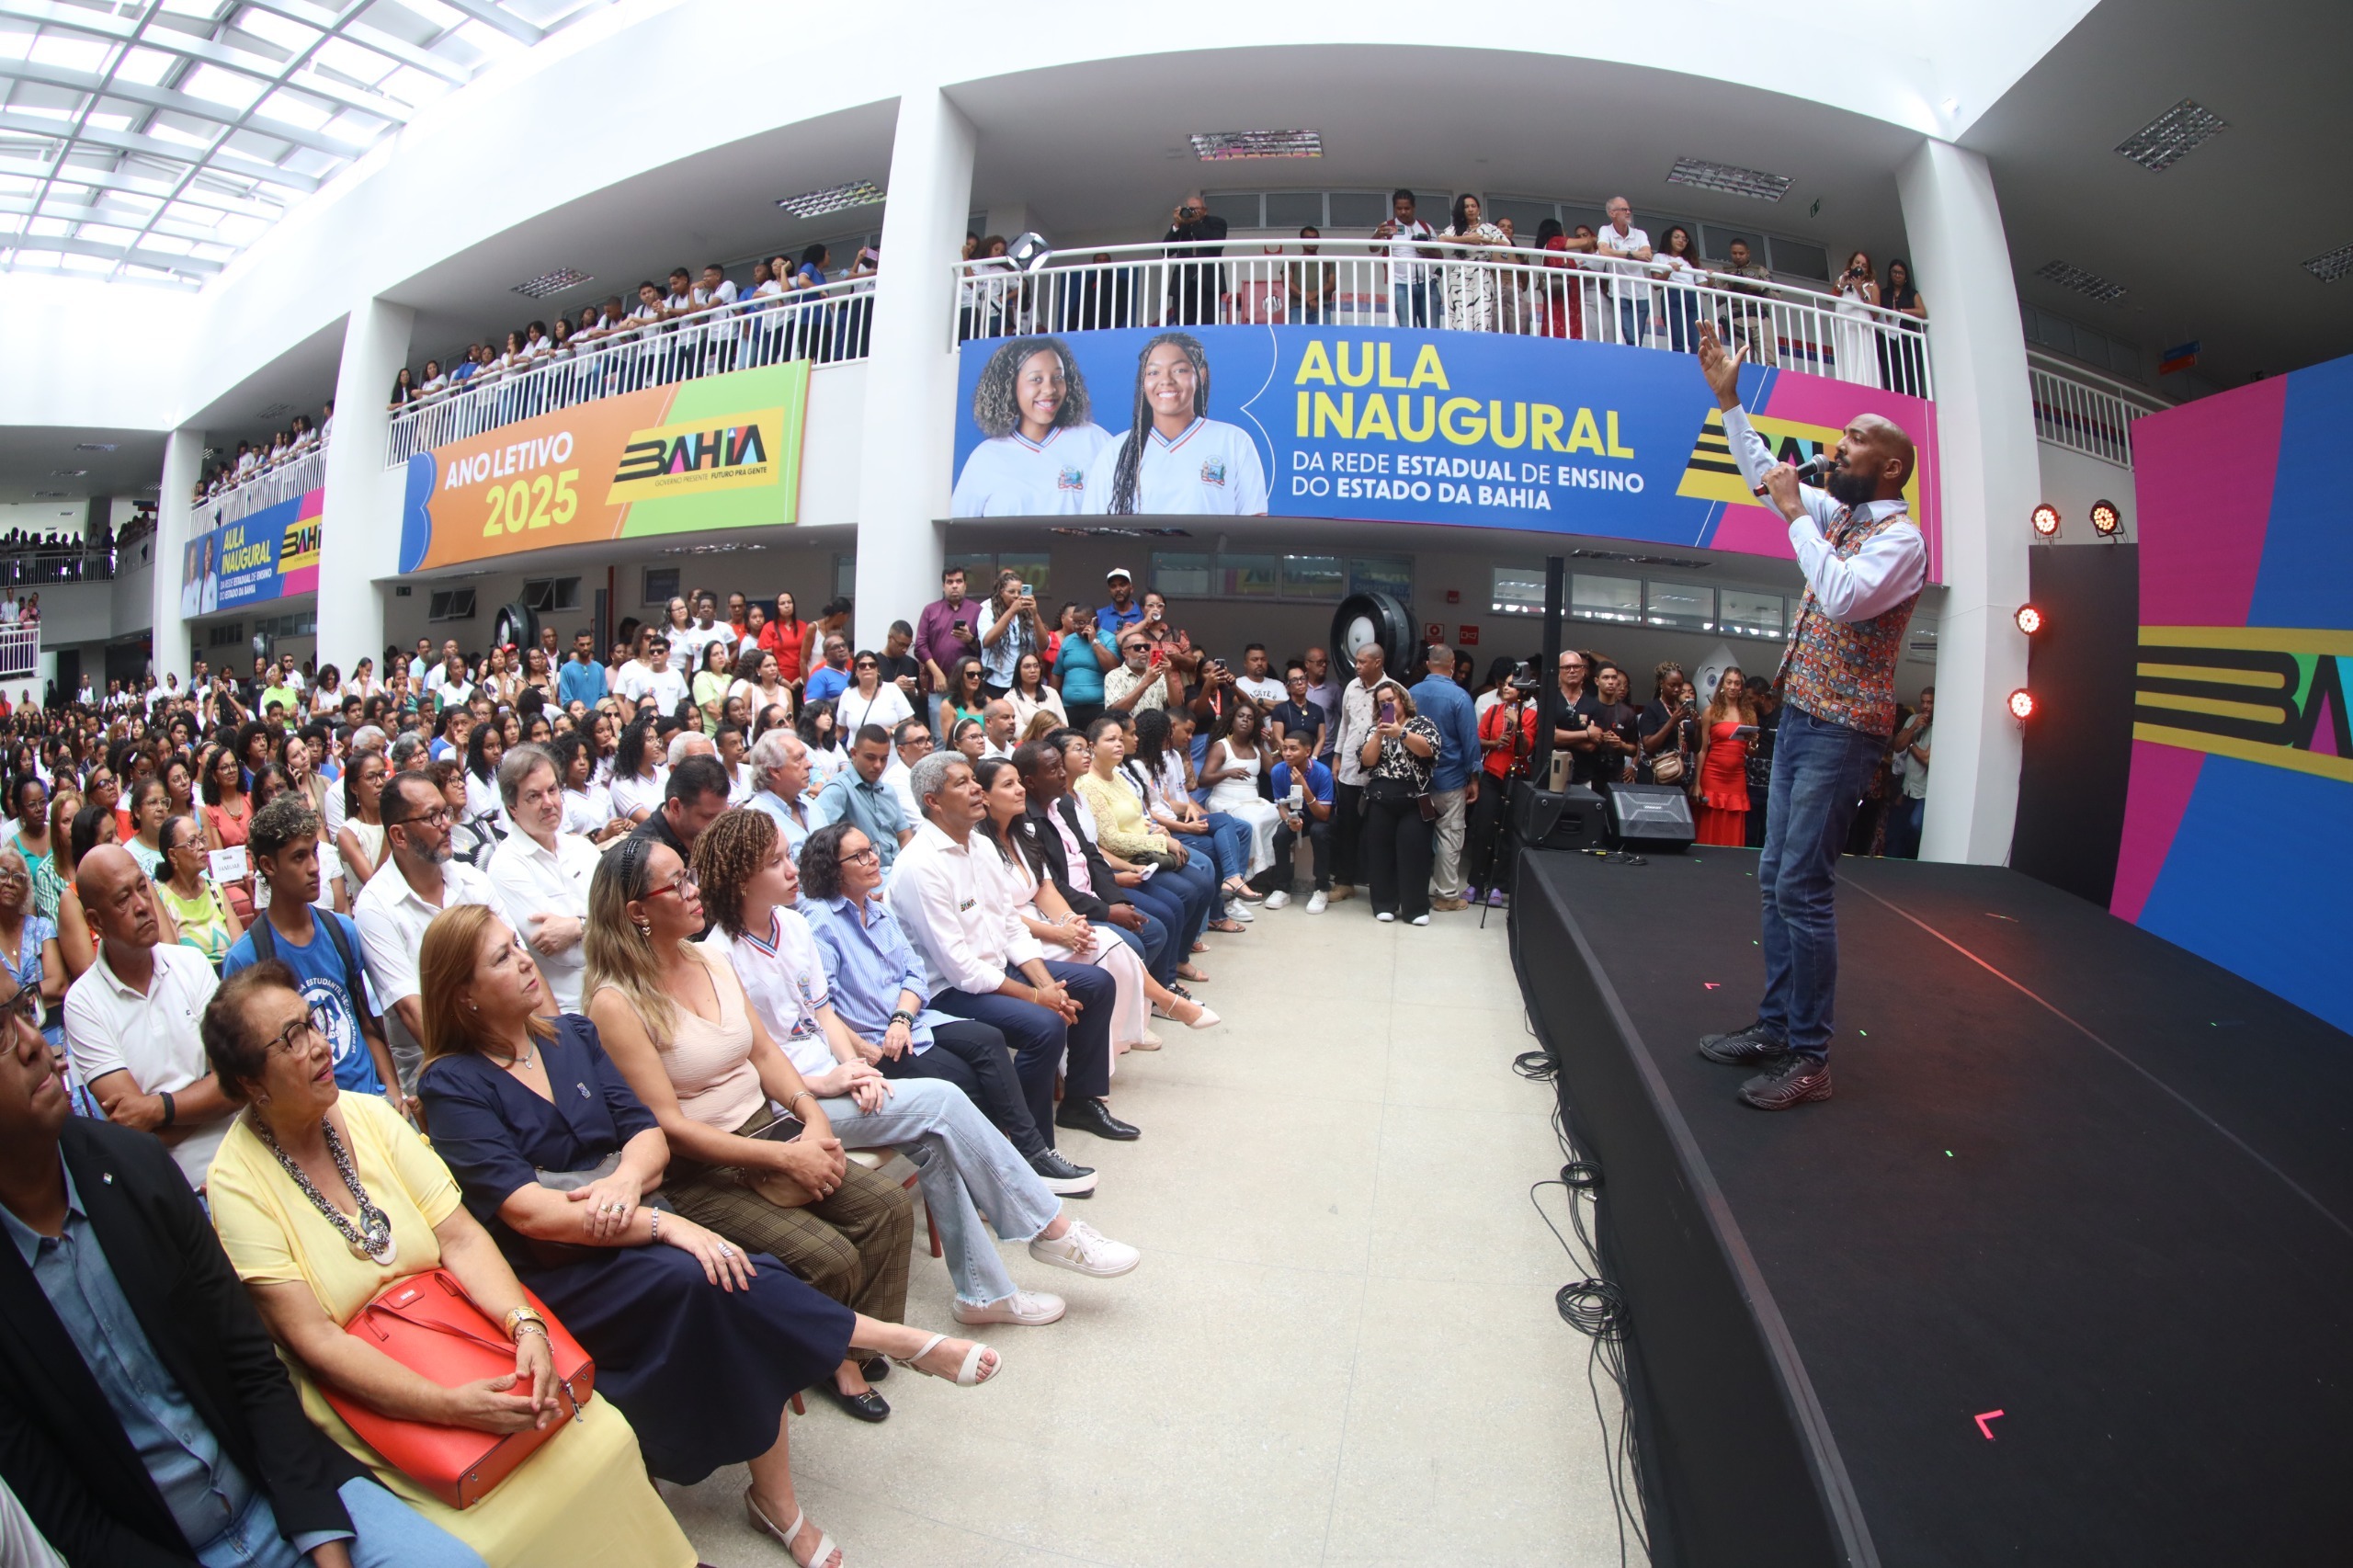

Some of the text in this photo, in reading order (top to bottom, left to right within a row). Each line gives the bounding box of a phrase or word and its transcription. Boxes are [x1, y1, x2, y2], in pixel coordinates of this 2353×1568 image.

[1293, 340, 1451, 391] AULA
[1296, 390, 1635, 460] INAUGURAL
[444, 431, 574, 491] ANO LETIVO
[613, 424, 767, 483] BAHIA
[654, 466, 767, 487] GOVERNO PRESENTE FUTURO PRA GENTE
[1292, 450, 1644, 494] DA REDE ESTADUAL DE ENSINO
[483, 468, 580, 538] 2025
[1292, 475, 1552, 511] DO ESTADO DA BAHIA
[222, 540, 271, 575] INAUGURAL
[223, 525, 244, 552] AULA
[279, 523, 322, 559] BAHI
[306, 977, 357, 1053] ESTUDANTIL SECUNDARISTA
